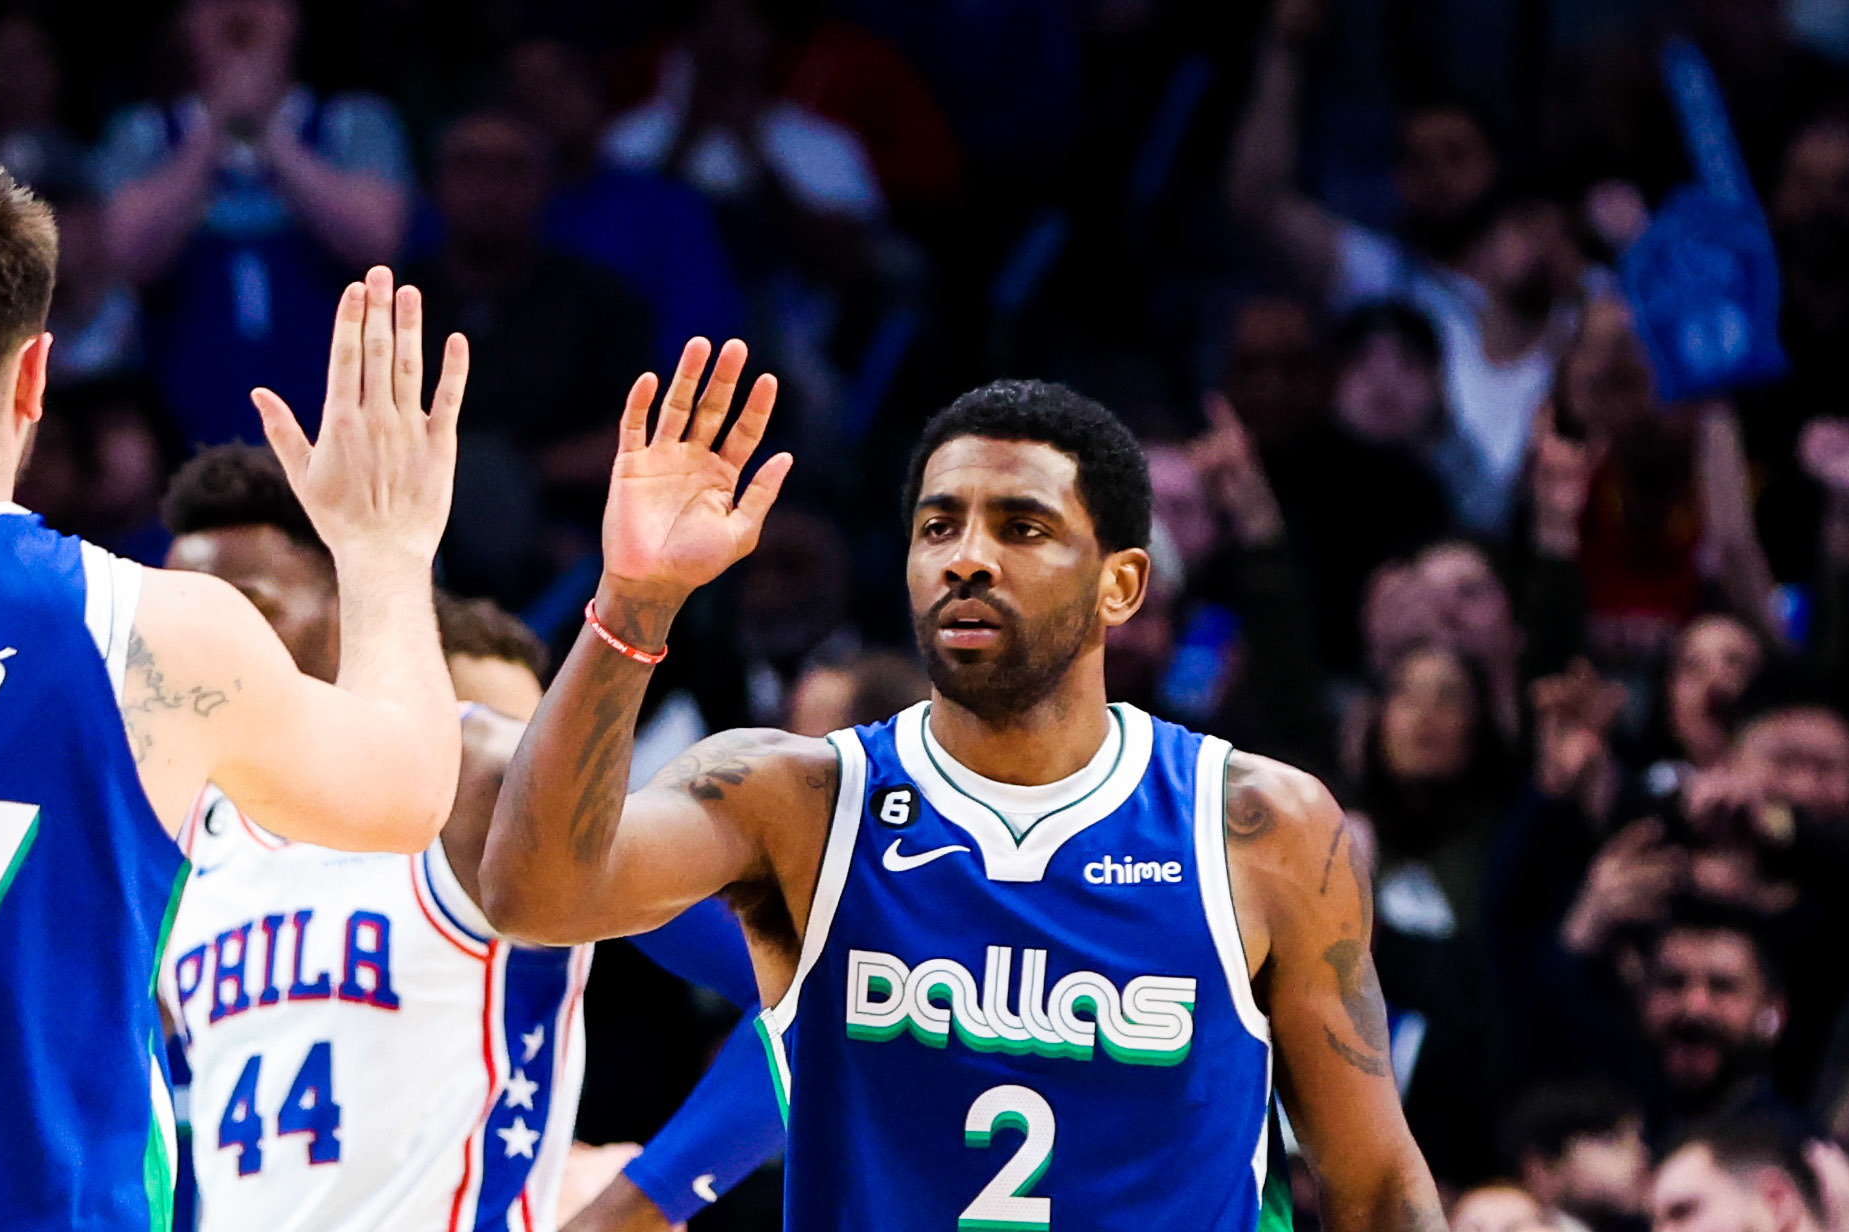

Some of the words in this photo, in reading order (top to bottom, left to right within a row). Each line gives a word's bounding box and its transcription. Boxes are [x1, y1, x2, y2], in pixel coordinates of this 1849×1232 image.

[880, 790, 911, 824] 6
[1083, 855, 1183, 885] chime
[175, 909, 401, 1028] PHILA
[217, 1041, 342, 1177] 44
